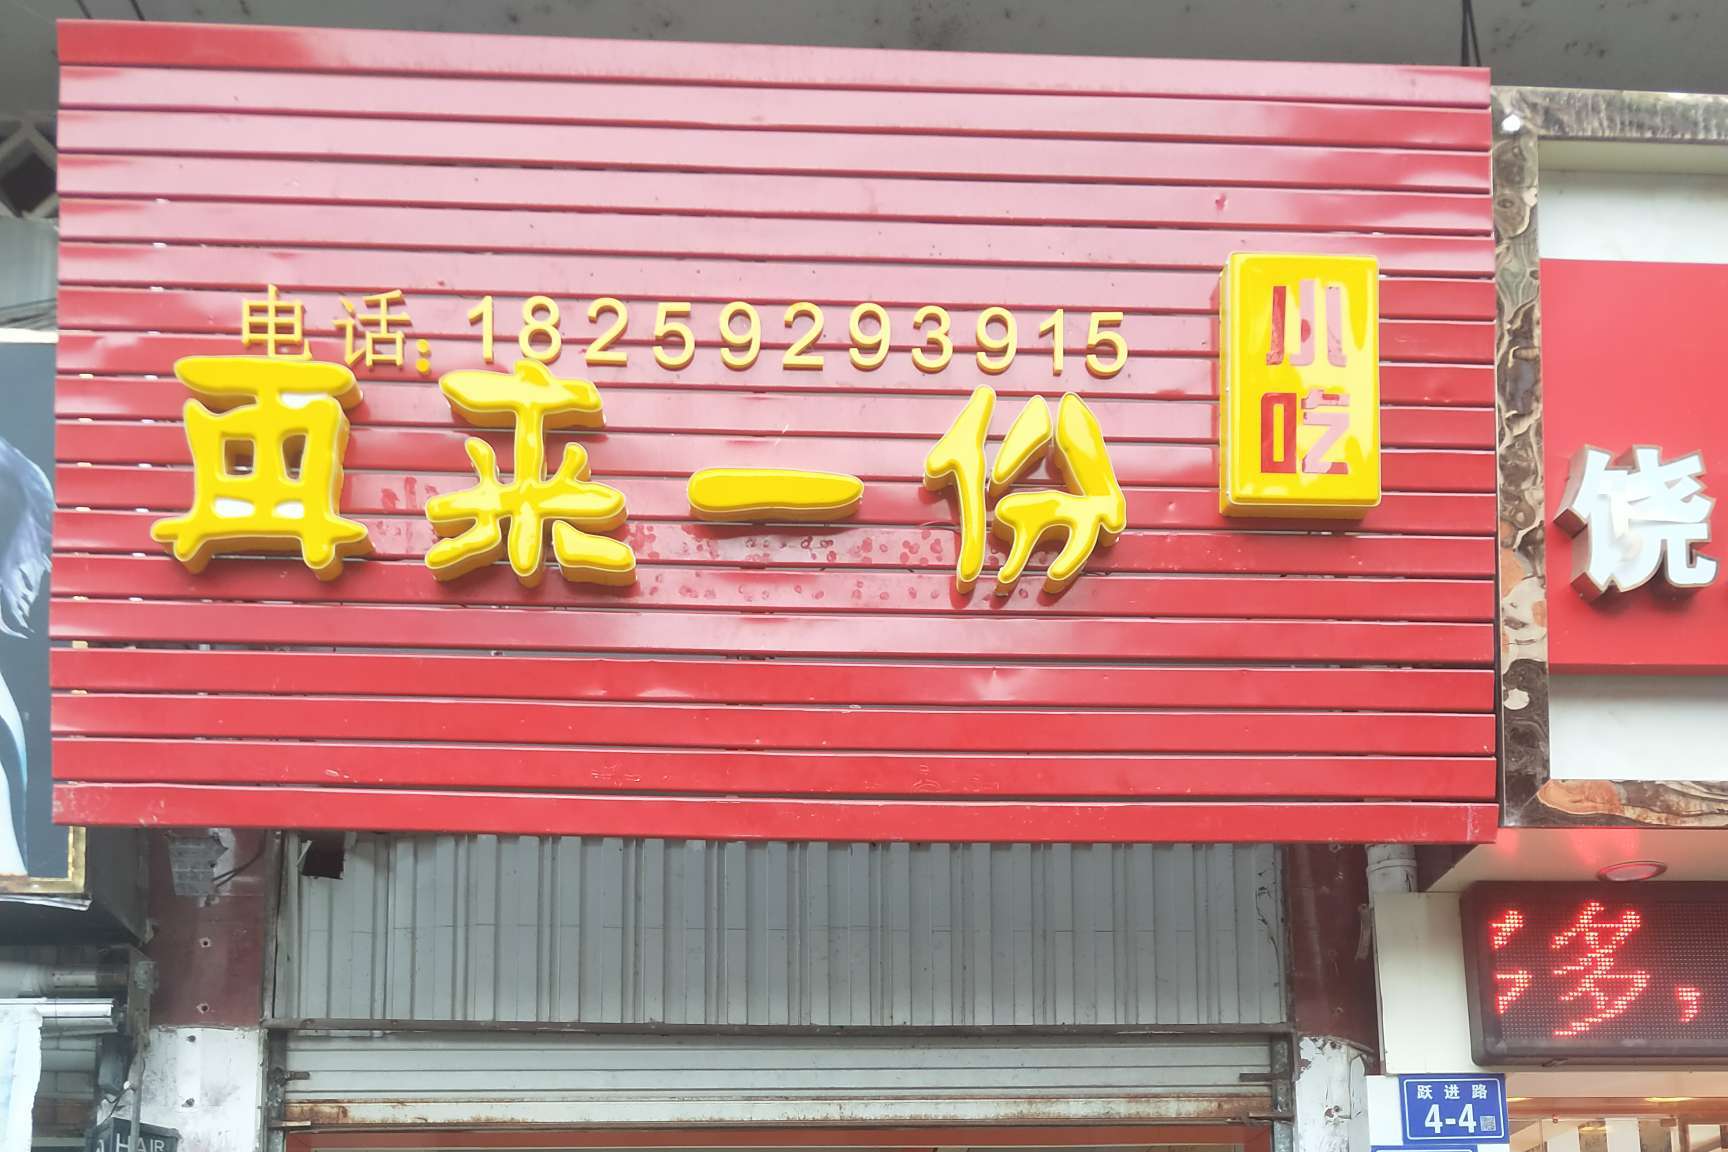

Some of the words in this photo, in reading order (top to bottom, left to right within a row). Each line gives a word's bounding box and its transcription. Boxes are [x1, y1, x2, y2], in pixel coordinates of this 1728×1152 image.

[1261, 279, 1350, 475] 小吃
[151, 356, 1128, 594] 再来一份
[1416, 1084, 1488, 1100] 跃进路
[1424, 1103, 1477, 1134] 4-4
